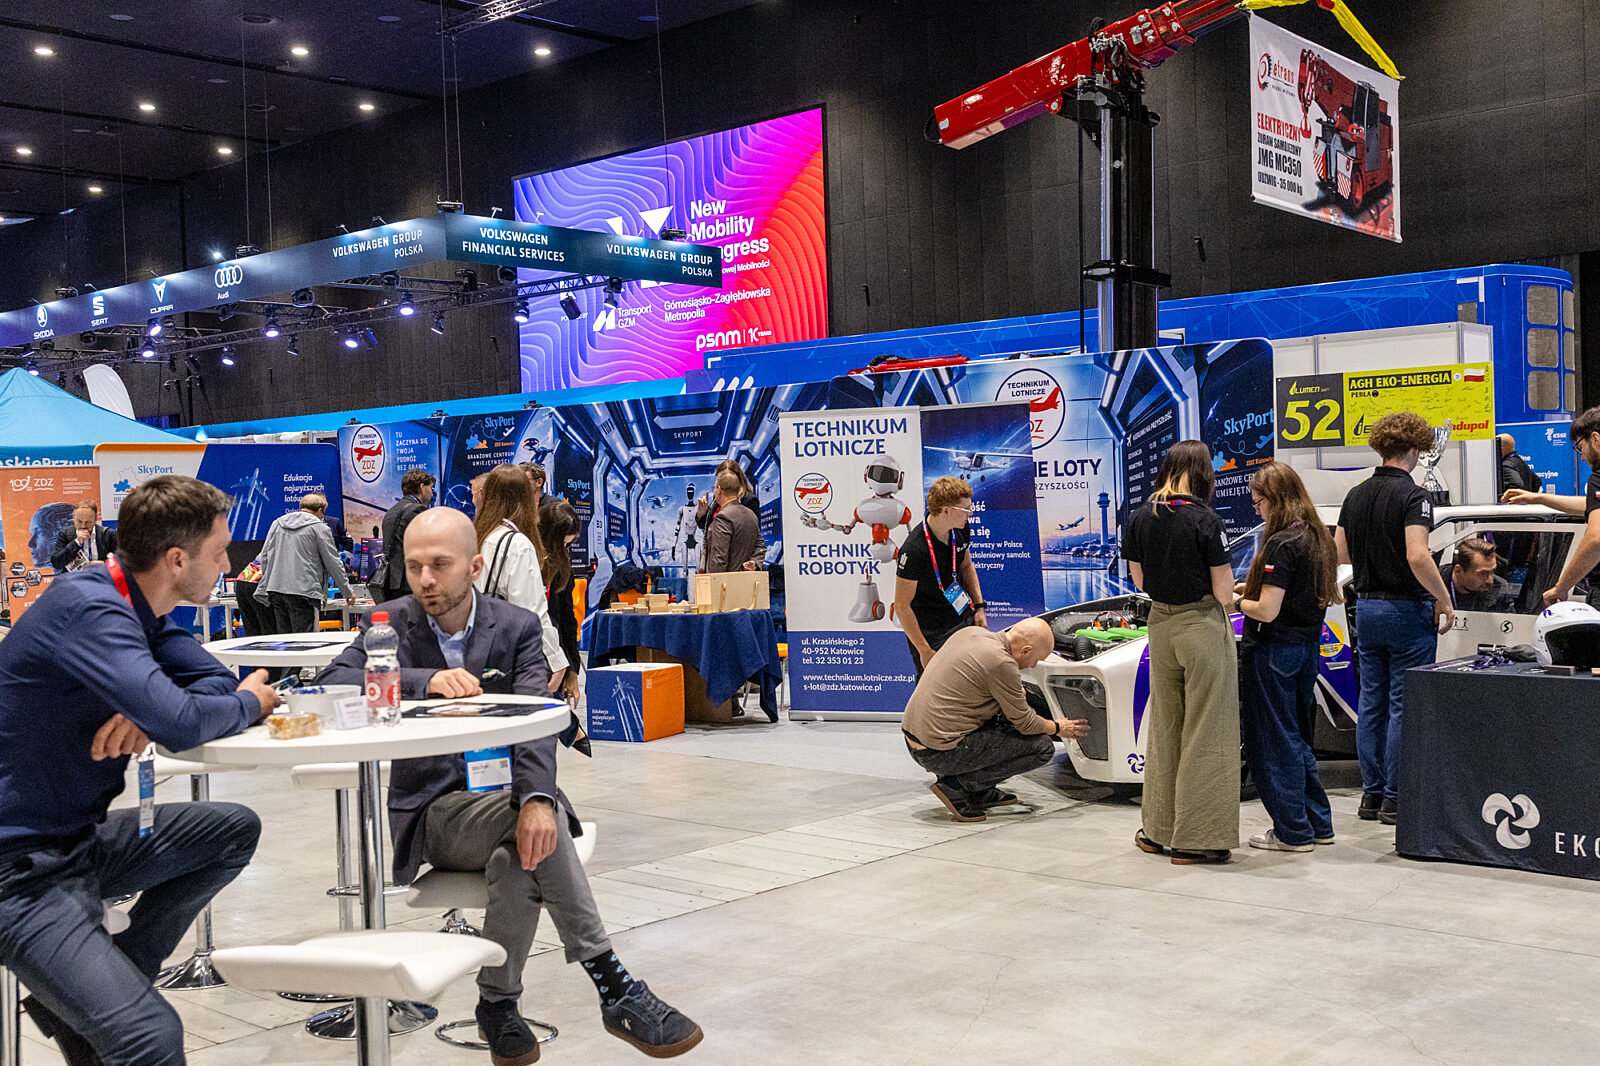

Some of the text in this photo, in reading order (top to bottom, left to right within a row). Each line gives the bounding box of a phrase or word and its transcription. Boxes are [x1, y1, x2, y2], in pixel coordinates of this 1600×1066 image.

[1257, 112, 1301, 142] ELEKTRYCZNY
[1258, 147, 1302, 178] JMG MC350
[1280, 177, 1287, 190] 35
[690, 199, 727, 220] New
[691, 215, 755, 242] Mobility
[480, 227, 548, 246] VOLKSWAGEN
[332, 229, 423, 258] VOLKSWAGEN GROUP
[720, 237, 770, 263] ngress
[394, 243, 424, 258] POLSKA
[462, 241, 565, 262] FINANCIAL SERVICES
[606, 243, 713, 266] VOLKSWAGEN GROUP
[681, 265, 713, 277] POLSKA
[722, 259, 770, 274] owej Mobilności
[217, 291, 230, 300] Audi
[664, 286, 771, 311] Górnośląsko-Zagłębiowska
[150, 304, 174, 314] CUPRA
[617, 304, 653, 317] Transport
[664, 308, 706, 323] Metropolia
[91, 317, 109, 327] SEAT
[617, 318, 636, 329] GZM
[695, 329, 742, 351] psnm
[1007, 380, 1050, 389] TECHNIKUM
[1350, 373, 1451, 389] AGH EKO-ENERGIA
[1011, 389, 1046, 397] LOTNICZE
[484, 416, 516, 430] SkyPort
[1223, 408, 1274, 436] SkyPort
[1281, 399, 1342, 441] 52
[1451, 419, 1489, 433] ndupol
[793, 417, 908, 438] TECHNIKUM
[673, 430, 703, 439] SKYPORT
[396, 437, 429, 447] ZACZYNA SIĘ
[794, 438, 886, 458] LOTNICZE
[396, 447, 414, 455] TWOJA
[137, 465, 174, 476] SkyPort
[362, 460, 376, 470] ZDZ
[1054, 459, 1102, 477] LOTY
[34, 478, 55, 487] ZDZ
[283, 474, 313, 483] Edukacja
[567, 478, 591, 491] SkyPort
[1214, 475, 1243, 488] RANŻOWE
[283, 483, 325, 493] najwyższych
[1034, 481, 1089, 491] RZYSZŁOŚCI
[1215, 485, 1251, 498] UMIEJĘTN
[807, 497, 823, 505] ZDZ
[977, 526, 991, 539] się
[797, 543, 872, 558] TECHNIK
[1003, 540, 1023, 548] Polsce
[970, 550, 1031, 561] zkoleniowy samolot
[798, 560, 881, 576] ROBOTYK
[973, 562, 1005, 571] lektryczny
[801, 637, 865, 647] ul. Krasińskiego 2
[801, 647, 865, 655] 40-952 Katowice
[802, 656, 864, 665] tel. 32 353 01 23
[802, 673, 916, 683] www.technikum.lotnicze.zdz.pl
[803, 683, 882, 692] s-lot@zdz.katowice.pl
